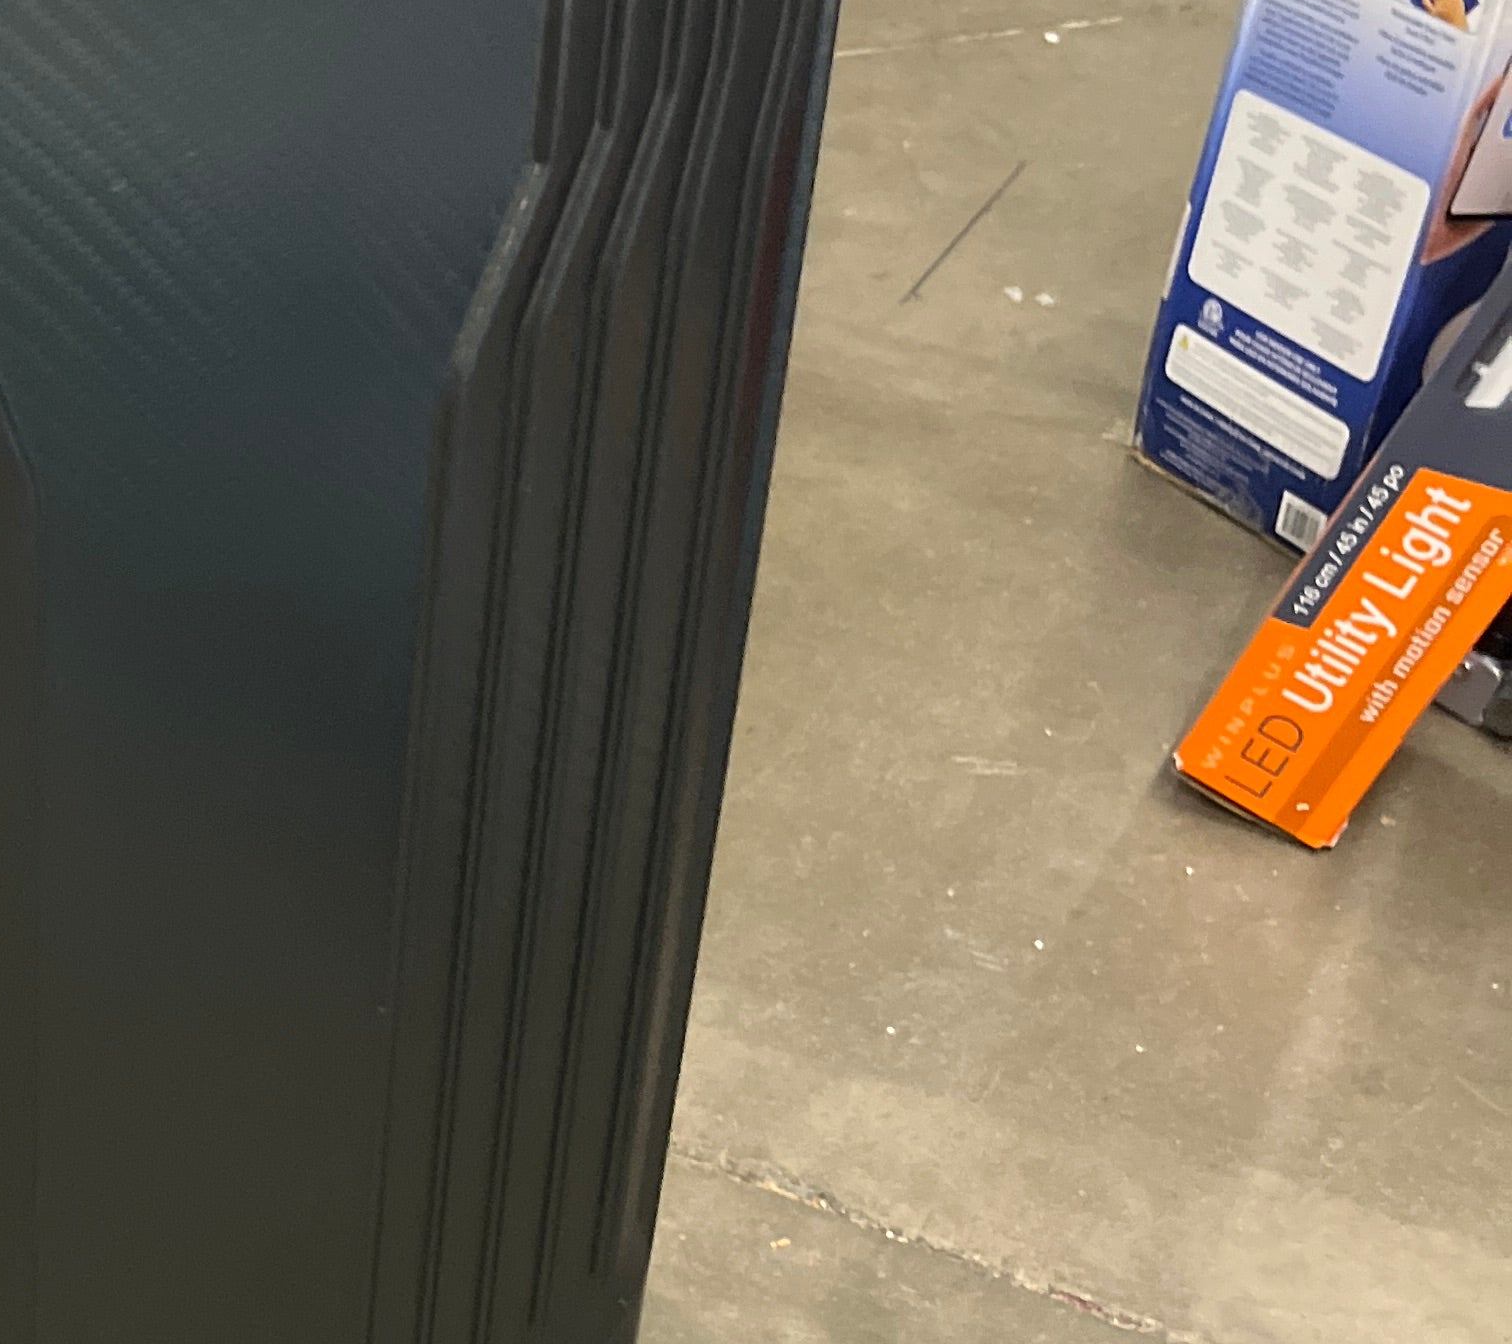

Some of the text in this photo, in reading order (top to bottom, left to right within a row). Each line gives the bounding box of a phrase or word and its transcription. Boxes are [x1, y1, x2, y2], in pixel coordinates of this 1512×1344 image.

[1382, 463, 1405, 492] po
[1366, 483, 1389, 511] 45
[1346, 516, 1369, 535] in
[1336, 530, 1358, 555] 45
[1314, 561, 1338, 588] cm
[1359, 526, 1505, 724] with motion sensor
[1223, 485, 1472, 799] LED Utility Light
[1200, 642, 1296, 769] WINPLUS
